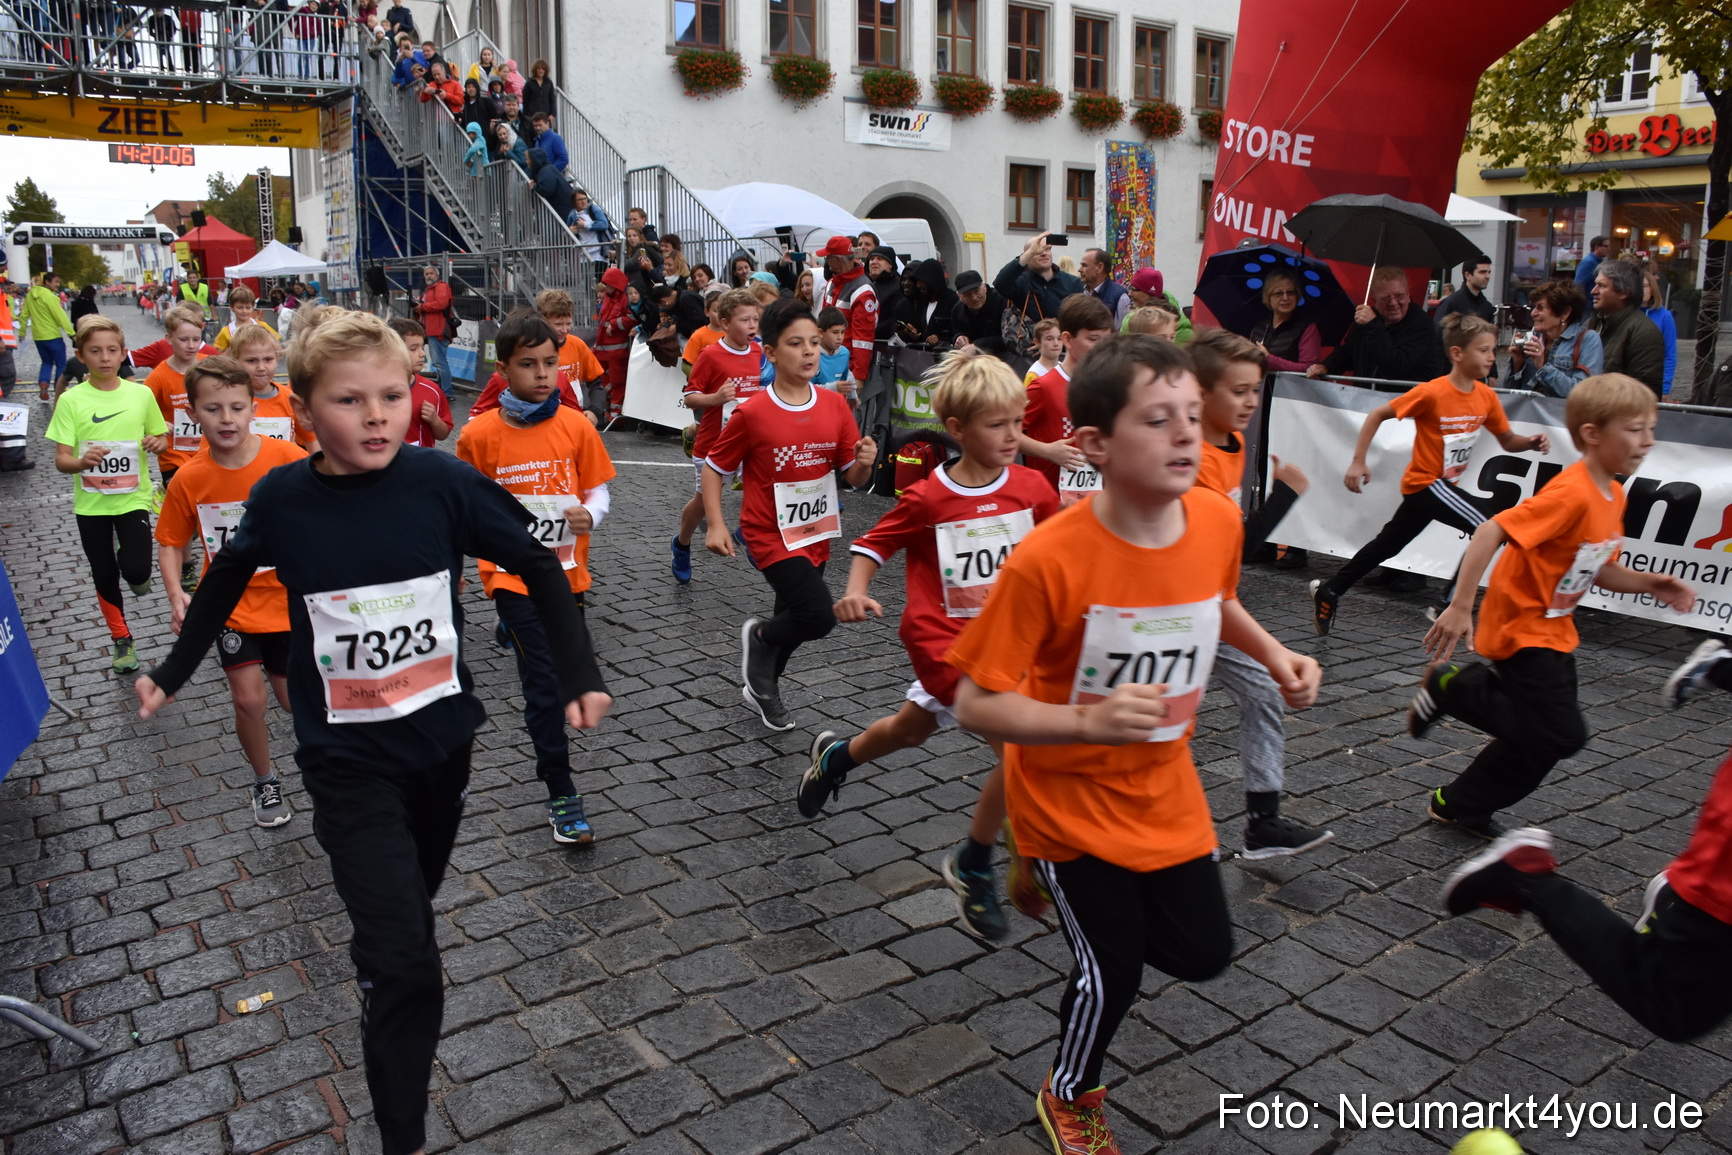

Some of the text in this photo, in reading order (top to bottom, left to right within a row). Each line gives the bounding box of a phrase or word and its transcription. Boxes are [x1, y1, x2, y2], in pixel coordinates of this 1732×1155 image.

[97, 107, 183, 136] ZIEL
[868, 113, 911, 131] swn
[1224, 118, 1315, 167] STORE
[1586, 130, 1635, 153] Der
[42, 226, 73, 237] MINI
[1213, 192, 1303, 244] ONLIN
[1067, 470, 1098, 488] 7079
[786, 494, 828, 524] 7046
[528, 518, 566, 542] 227
[956, 544, 1019, 581] 704
[335, 618, 438, 671] 7323
[1105, 645, 1199, 688] 7071
